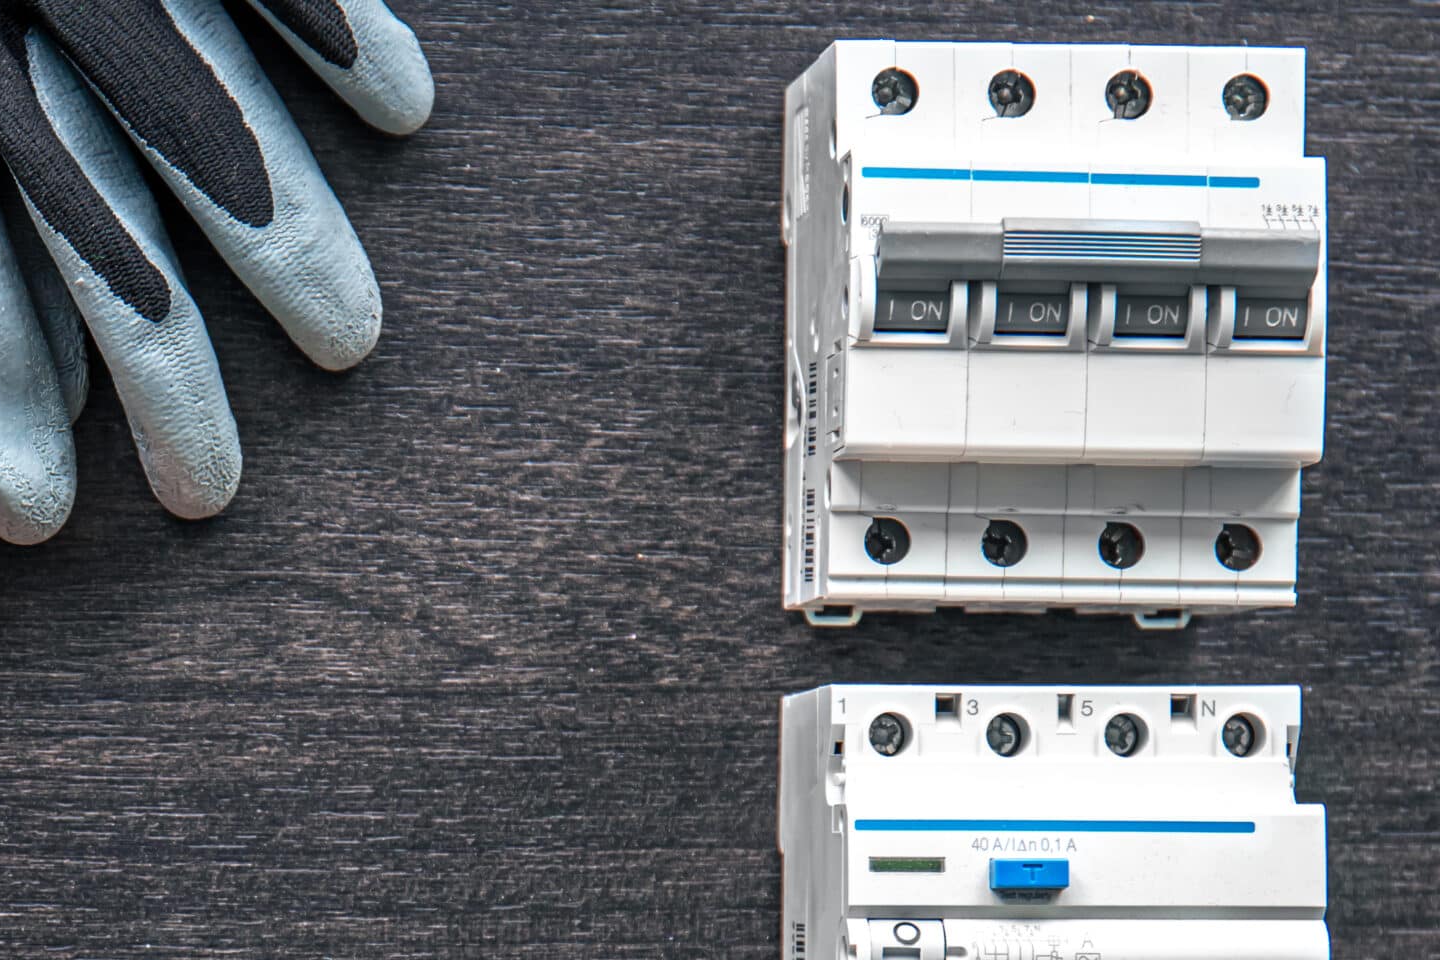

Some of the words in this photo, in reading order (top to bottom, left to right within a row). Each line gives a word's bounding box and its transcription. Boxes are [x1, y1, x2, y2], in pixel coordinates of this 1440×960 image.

[911, 300, 944, 321] ON
[1029, 302, 1062, 323] ON
[1146, 304, 1180, 325] ON
[1265, 306, 1299, 327] ON
[836, 699, 847, 715] 1
[966, 700, 979, 716] 3
[1081, 700, 1094, 716] 5
[1202, 700, 1216, 716] N
[971, 837, 989, 852] 40
